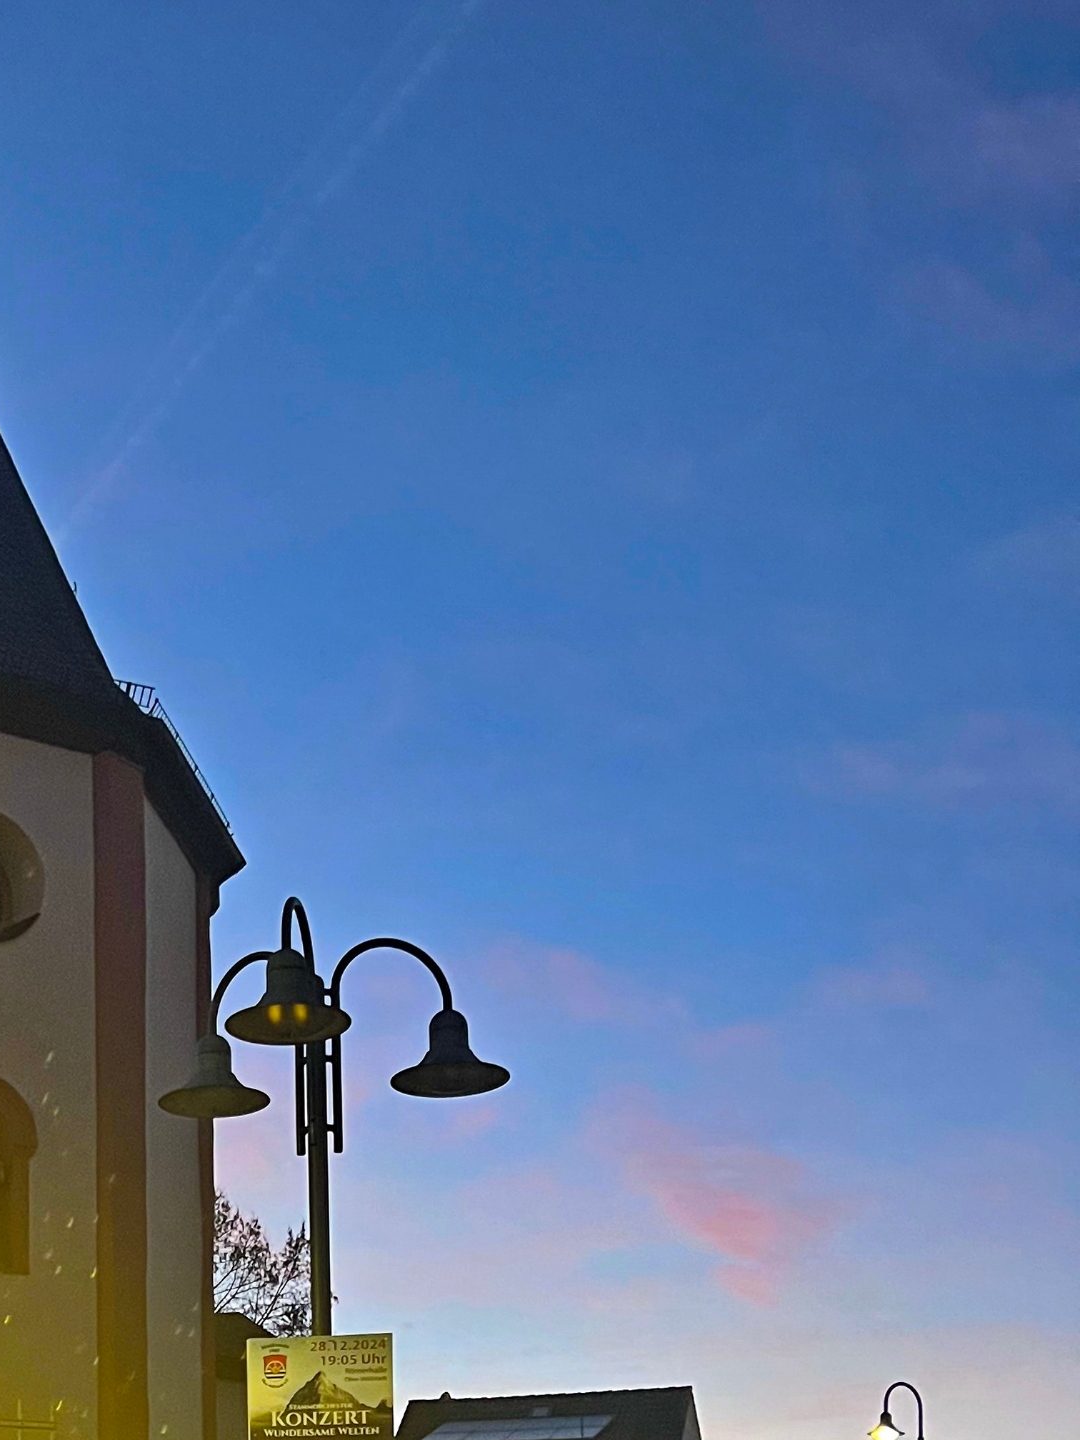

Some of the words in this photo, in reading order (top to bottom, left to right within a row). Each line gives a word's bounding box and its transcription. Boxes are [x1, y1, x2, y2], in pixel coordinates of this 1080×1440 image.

[310, 1339, 386, 1352] 28.12.2024
[321, 1354, 357, 1366] 19:05
[361, 1353, 387, 1365] Uhr
[271, 1409, 372, 1427] KONZERT
[263, 1427, 336, 1438] WUNDERSAME
[338, 1426, 380, 1436] WELTEN
